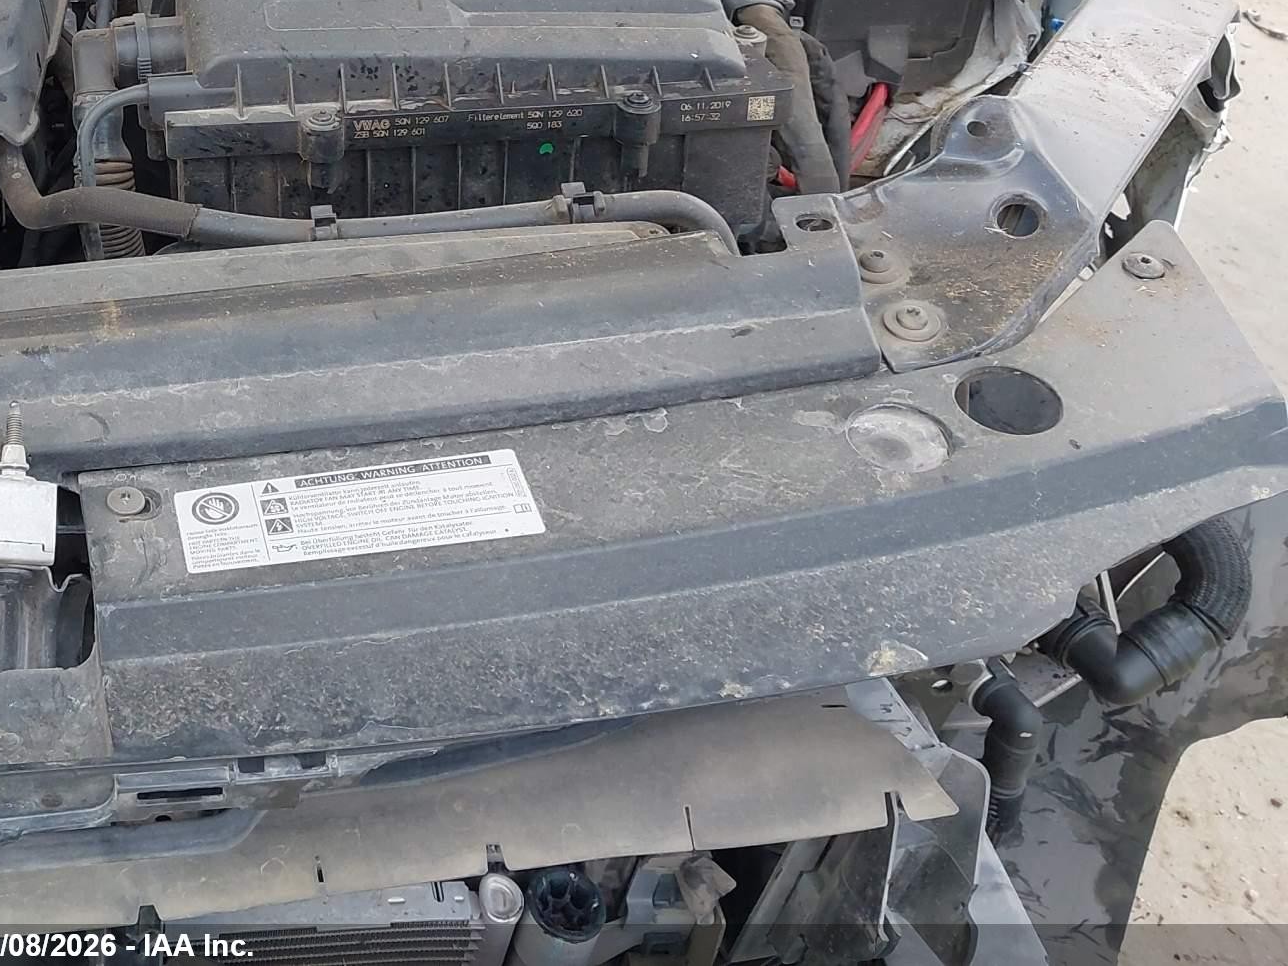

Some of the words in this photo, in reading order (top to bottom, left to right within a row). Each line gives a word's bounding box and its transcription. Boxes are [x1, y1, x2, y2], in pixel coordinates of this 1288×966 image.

[548, 110, 563, 118] 129
[567, 109, 583, 117] 620
[353, 119, 391, 131] VWAG
[433, 115, 449, 123] 607
[393, 129, 408, 137] 129
[300, 474, 355, 487] ACHTUNG
[360, 465, 416, 479] WARNING
[422, 457, 483, 472] ATTENTION
